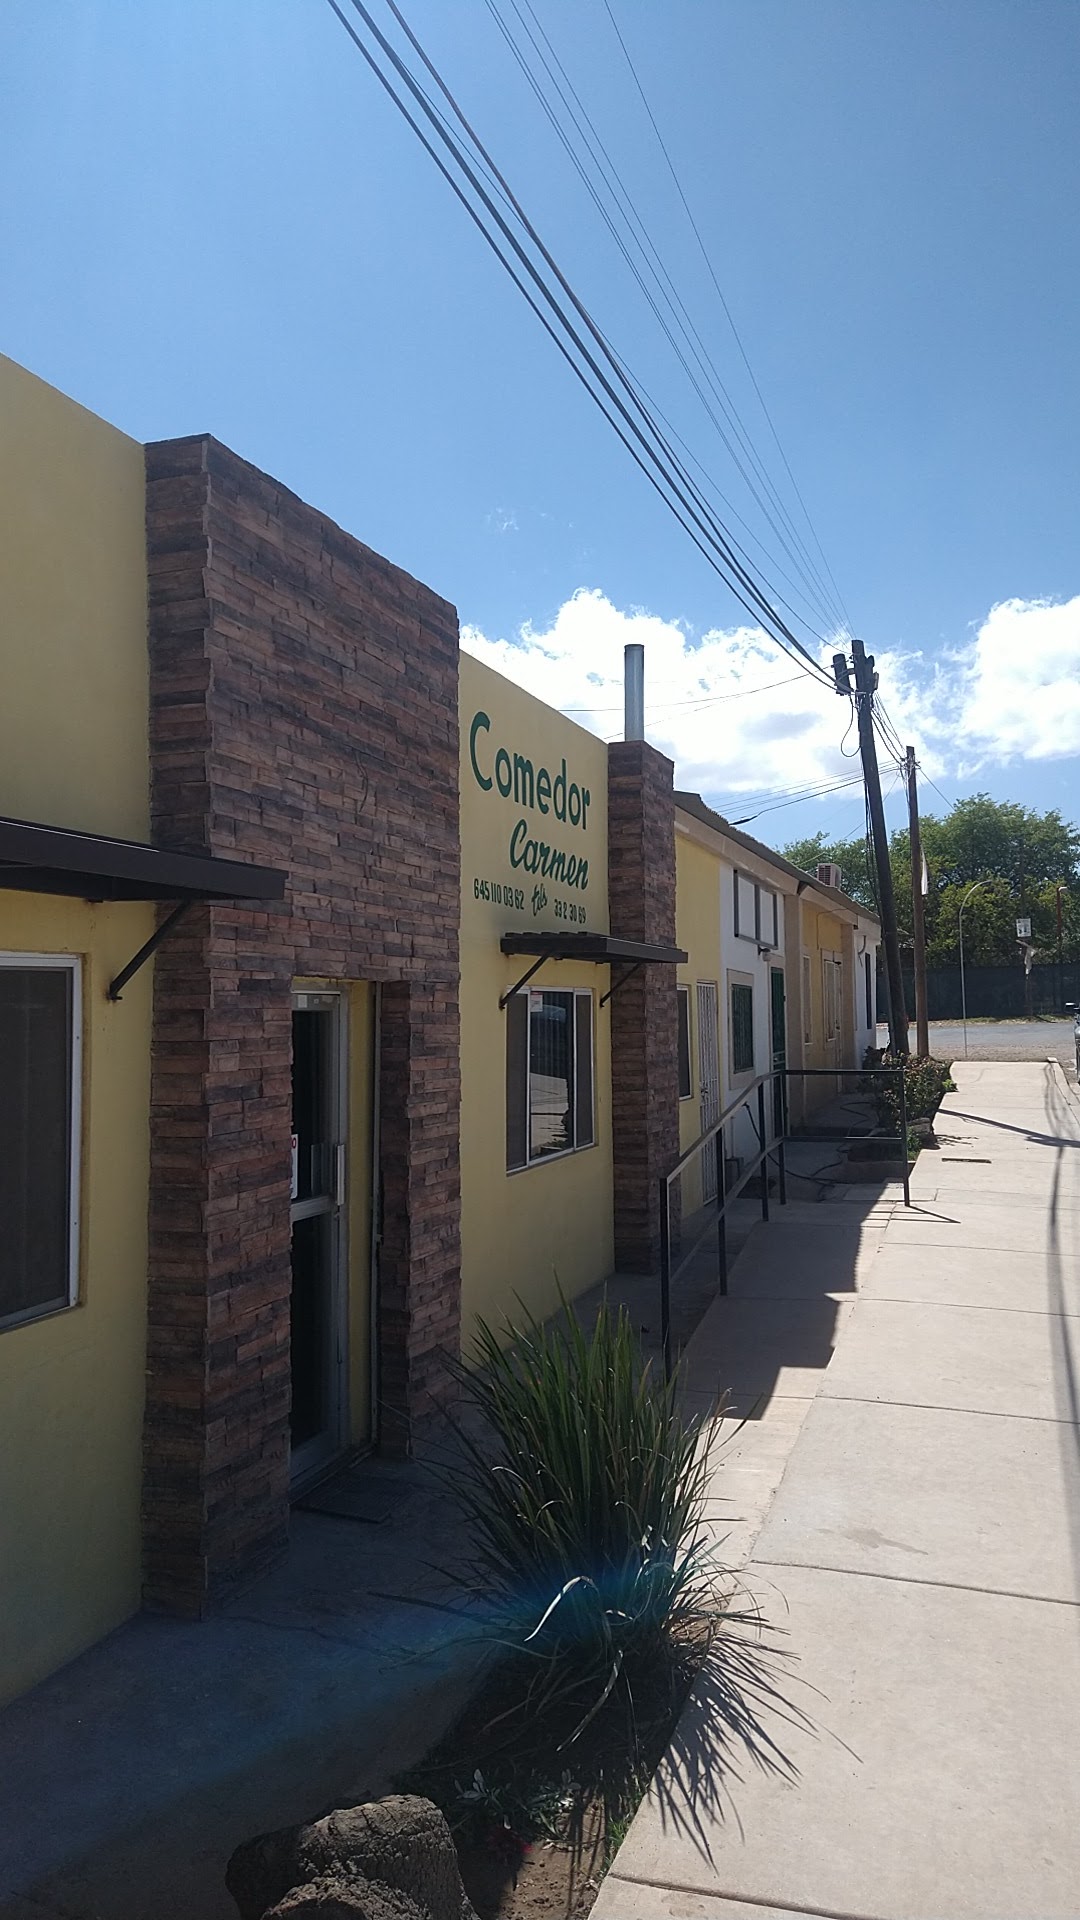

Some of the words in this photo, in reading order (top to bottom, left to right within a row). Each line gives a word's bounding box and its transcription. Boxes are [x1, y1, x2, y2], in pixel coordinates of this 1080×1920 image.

[469, 710, 591, 830] Comedor
[473, 878, 490, 901] 645
[509, 818, 589, 891] Carmen
